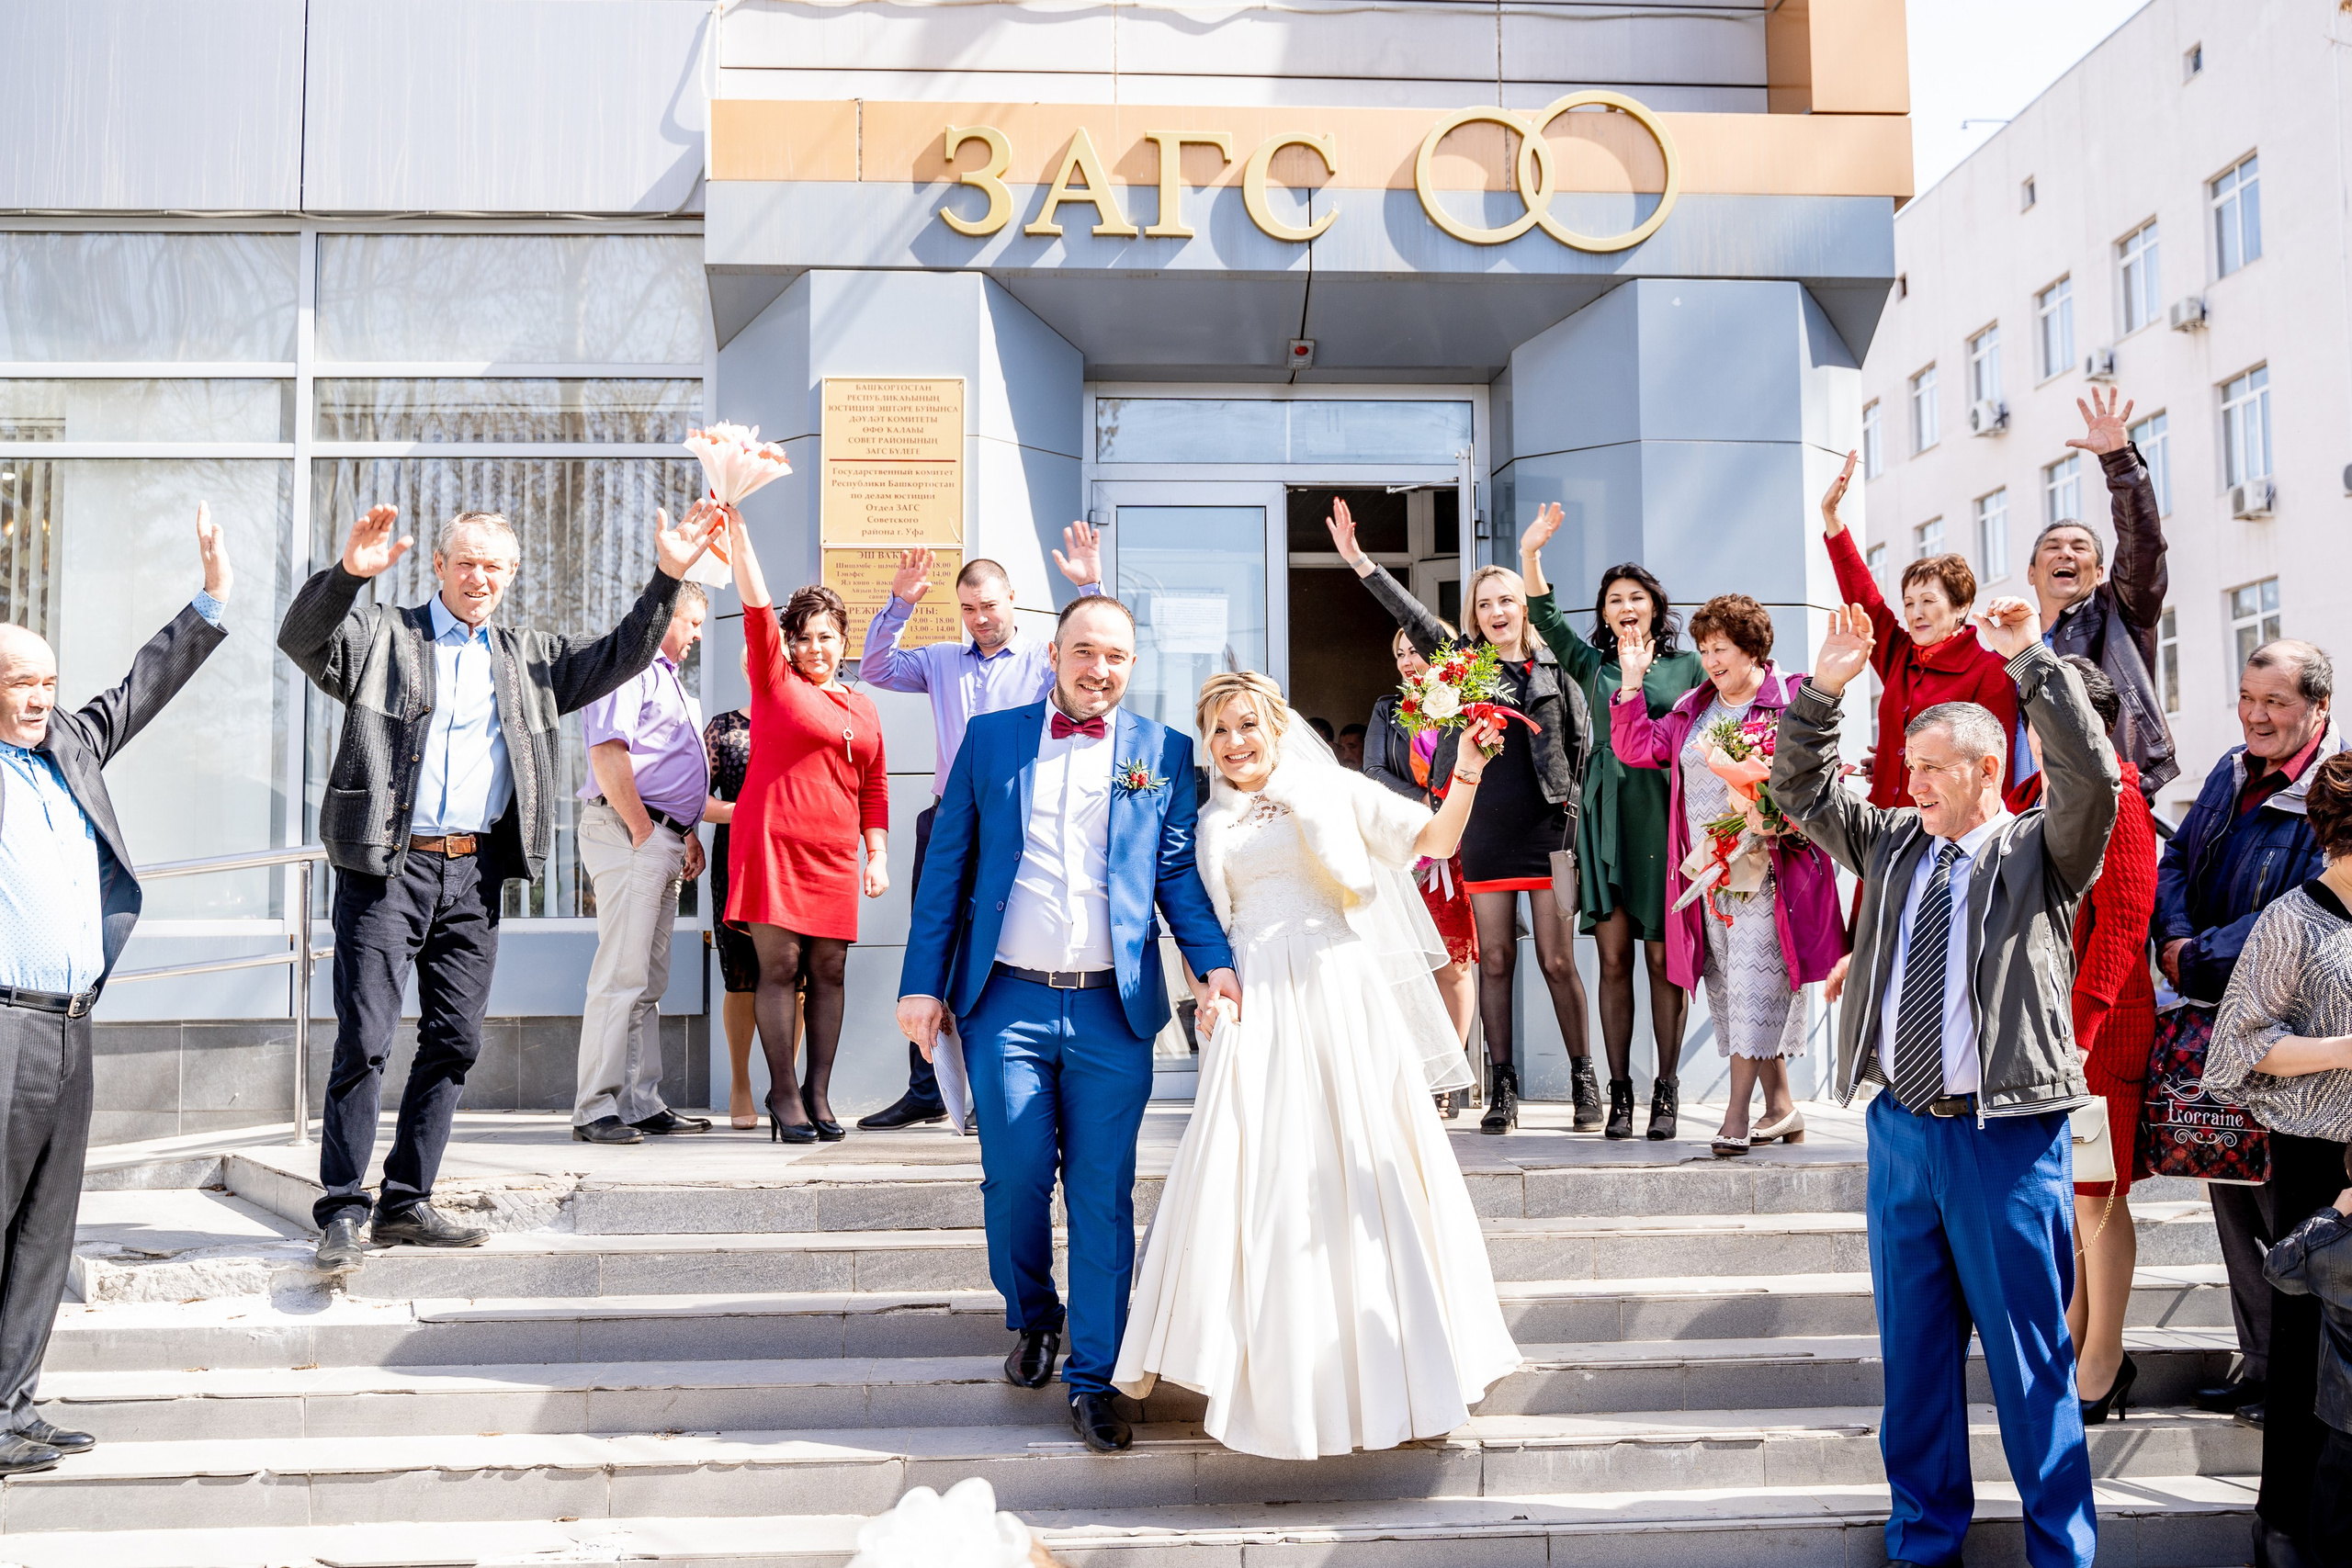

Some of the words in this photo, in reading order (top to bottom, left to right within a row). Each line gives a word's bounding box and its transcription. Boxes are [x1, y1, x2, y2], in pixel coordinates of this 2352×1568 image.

[939, 124, 1340, 243] ЗАГС
[915, 404, 958, 412] БУЙЫНСА
[832, 467, 913, 478] Государственный
[831, 479, 886, 490] Республики
[888, 479, 955, 490] Башкортостан
[865, 503, 894, 513] Отдел
[896, 503, 921, 512] ЗАГС
[866, 515, 919, 524] Советского
[862, 528, 895, 537] района
[906, 528, 924, 538] Уфа
[848, 606, 884, 615] РЕЖИ
[935, 616, 955, 625] 18.00
[2166, 1099, 2245, 1127] Lorraine
